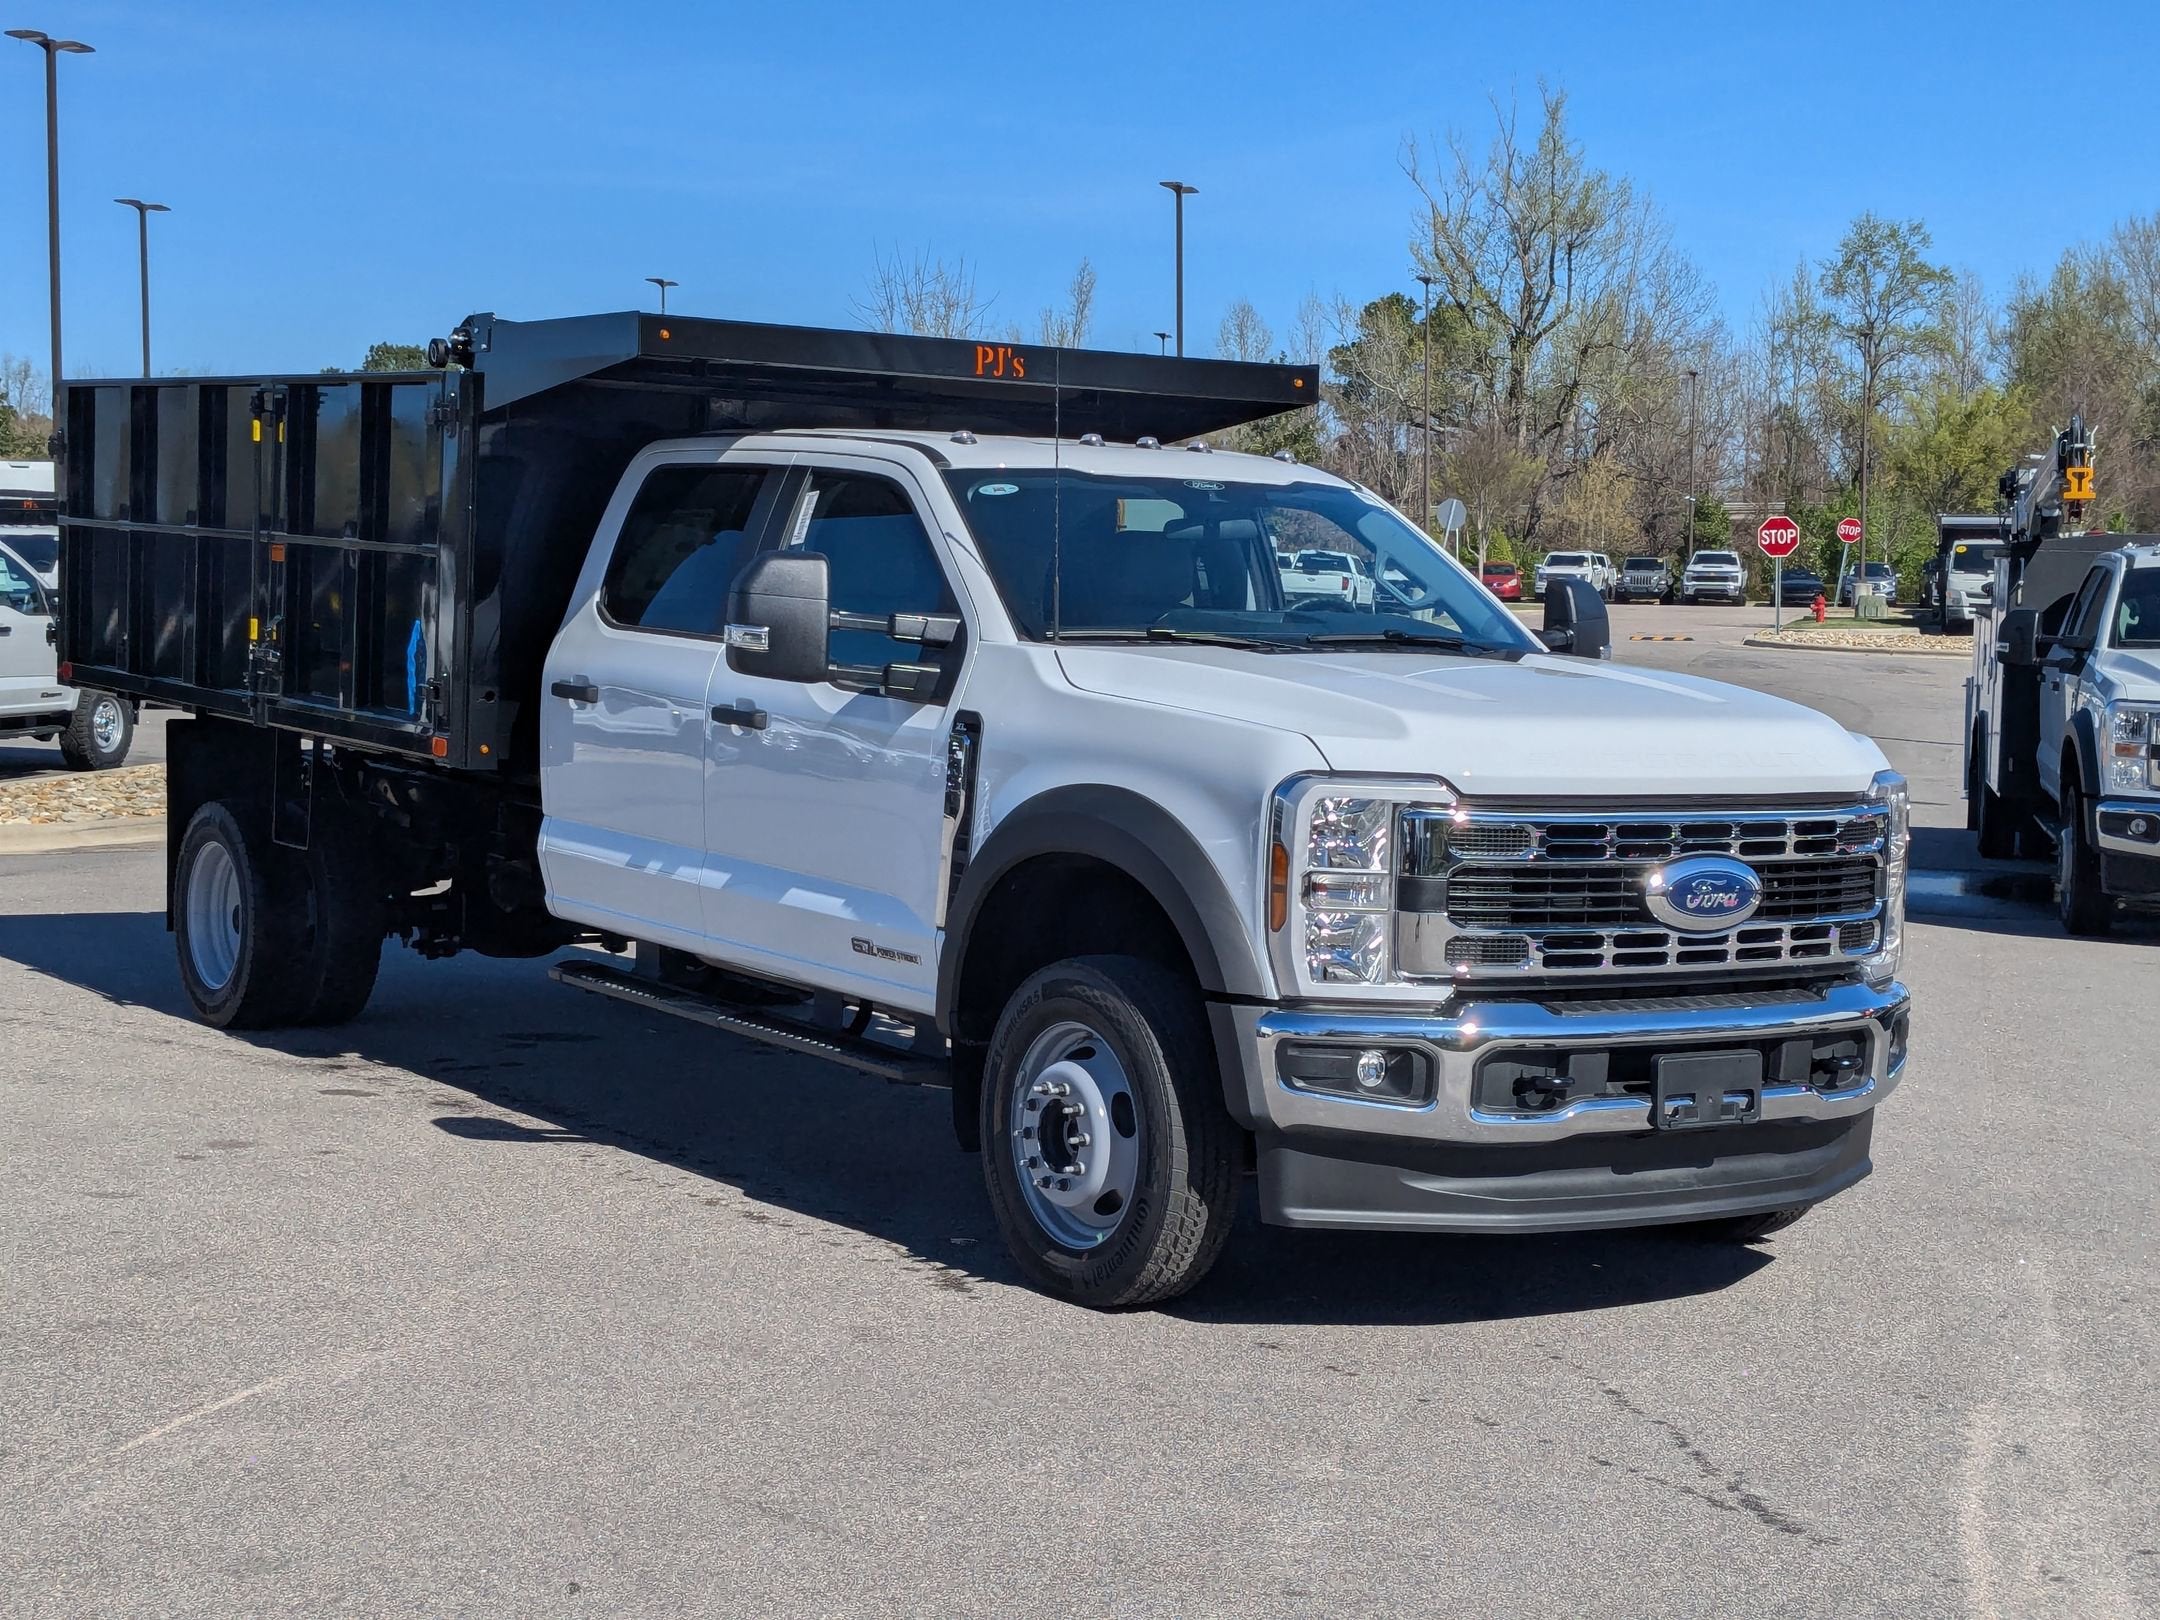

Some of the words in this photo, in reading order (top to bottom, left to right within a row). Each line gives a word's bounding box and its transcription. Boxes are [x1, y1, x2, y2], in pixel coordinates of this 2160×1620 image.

[976, 345, 1025, 378] PJ's
[1761, 528, 1797, 545] STOP
[1840, 525, 1861, 537] STOP
[1685, 878, 1741, 909] Ford
